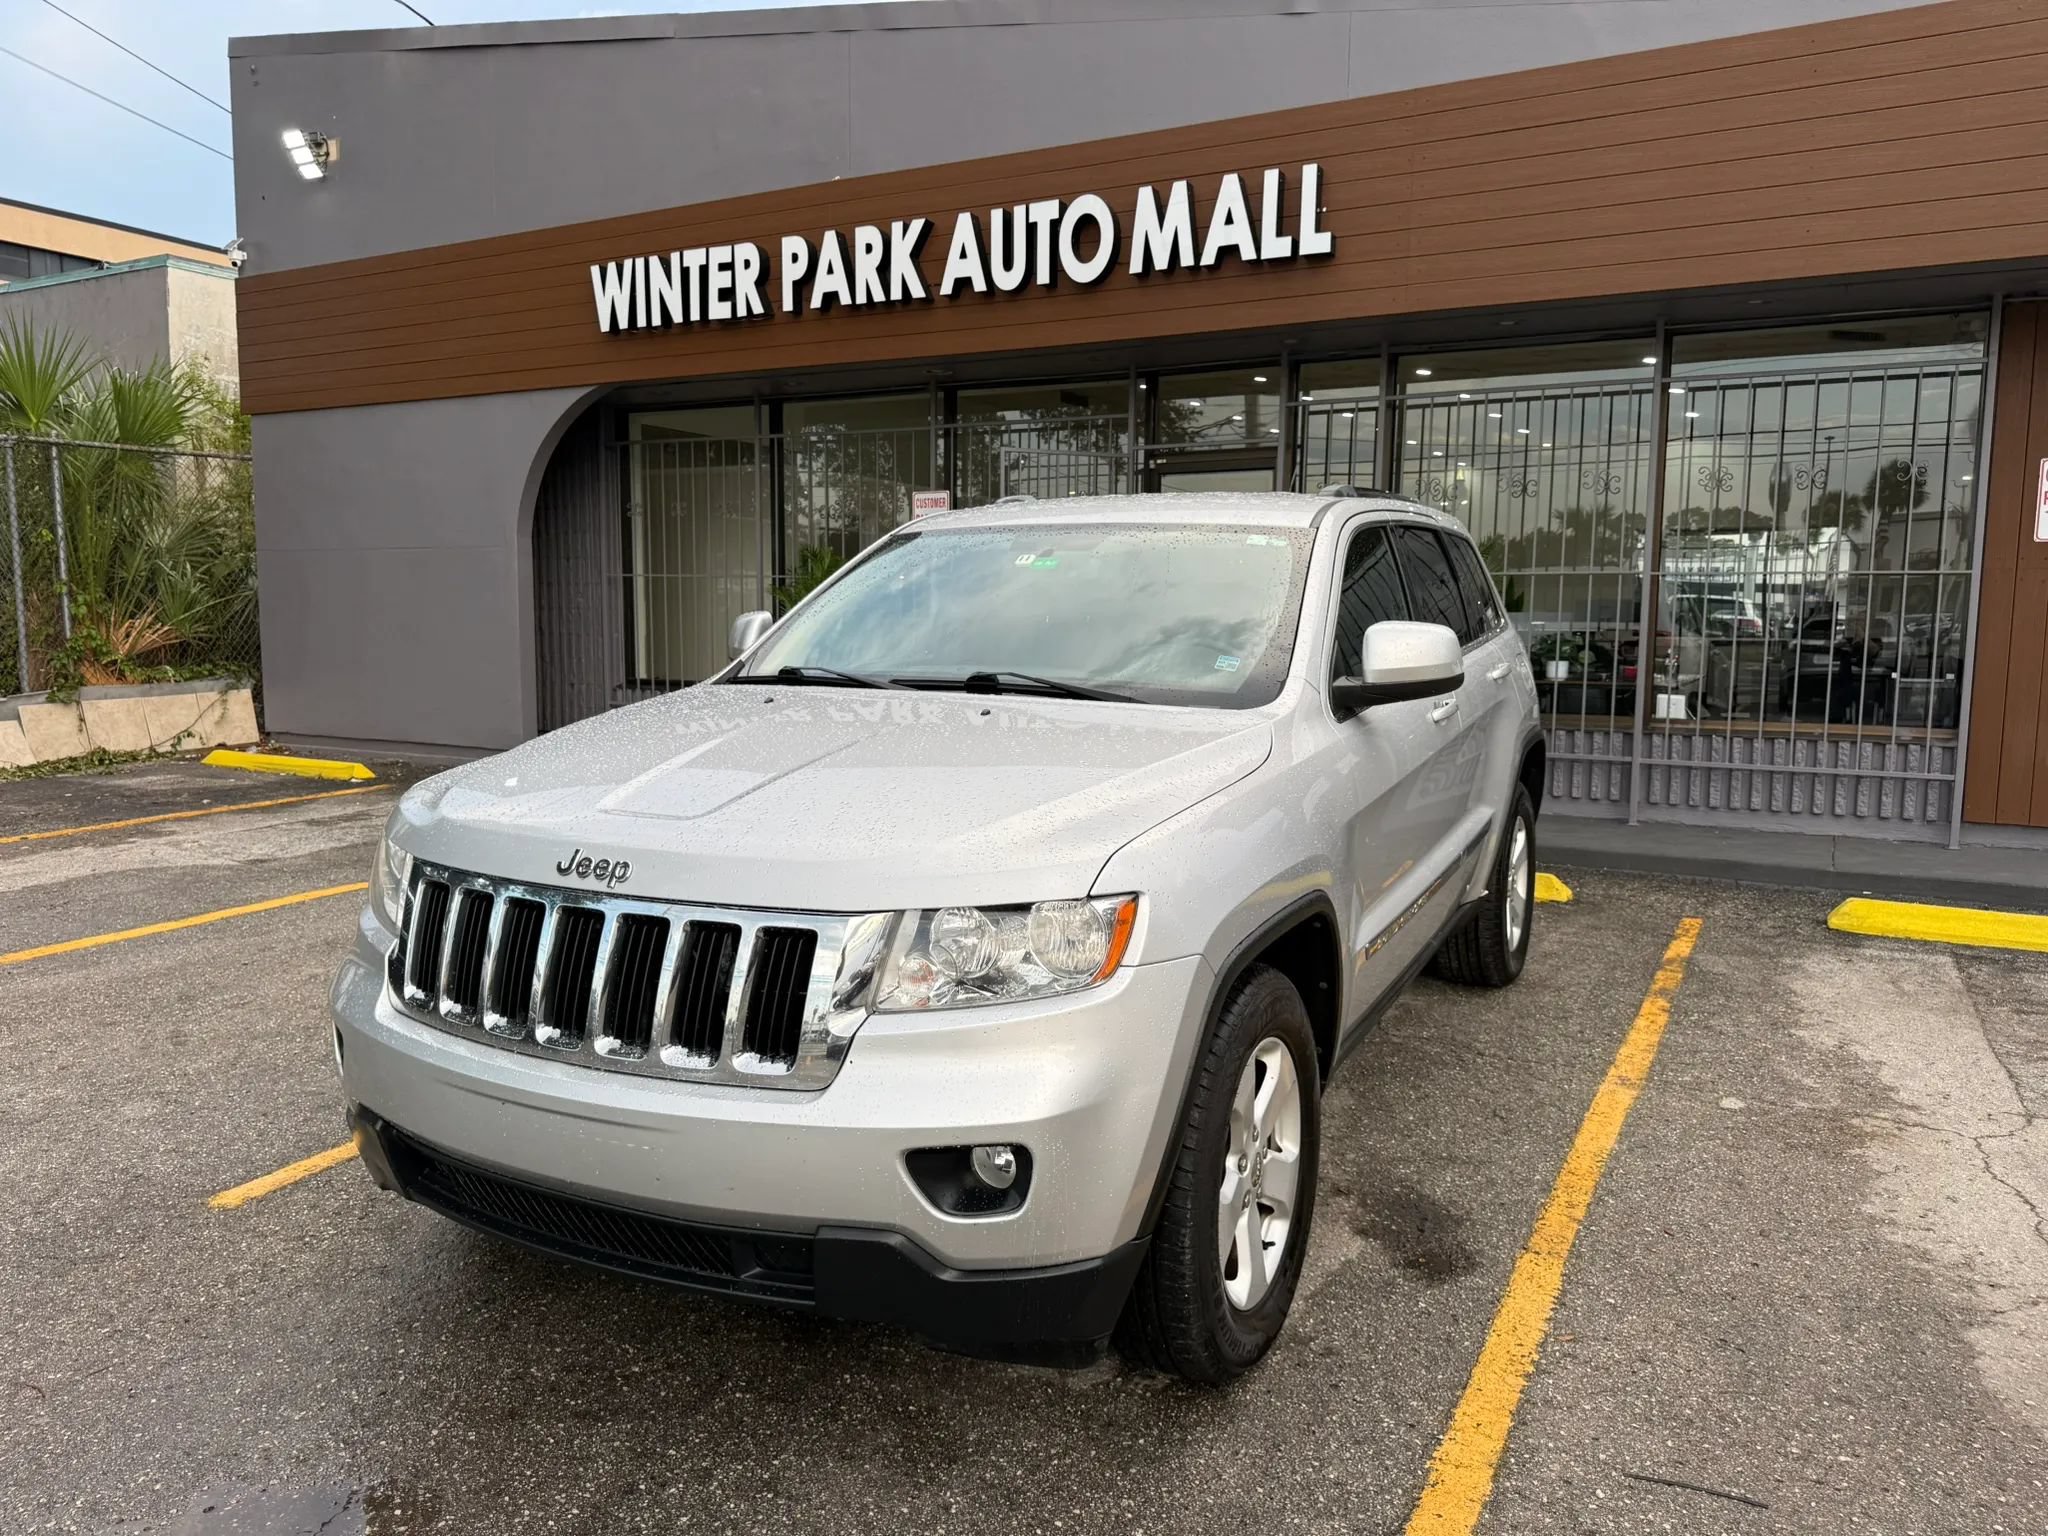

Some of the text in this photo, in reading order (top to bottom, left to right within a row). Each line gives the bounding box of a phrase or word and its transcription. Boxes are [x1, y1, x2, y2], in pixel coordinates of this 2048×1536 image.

[591, 163, 1333, 333] WINTER PARK AUTO MALL
[915, 497, 947, 510] CUSTOMER
[556, 848, 634, 889] Jeep
